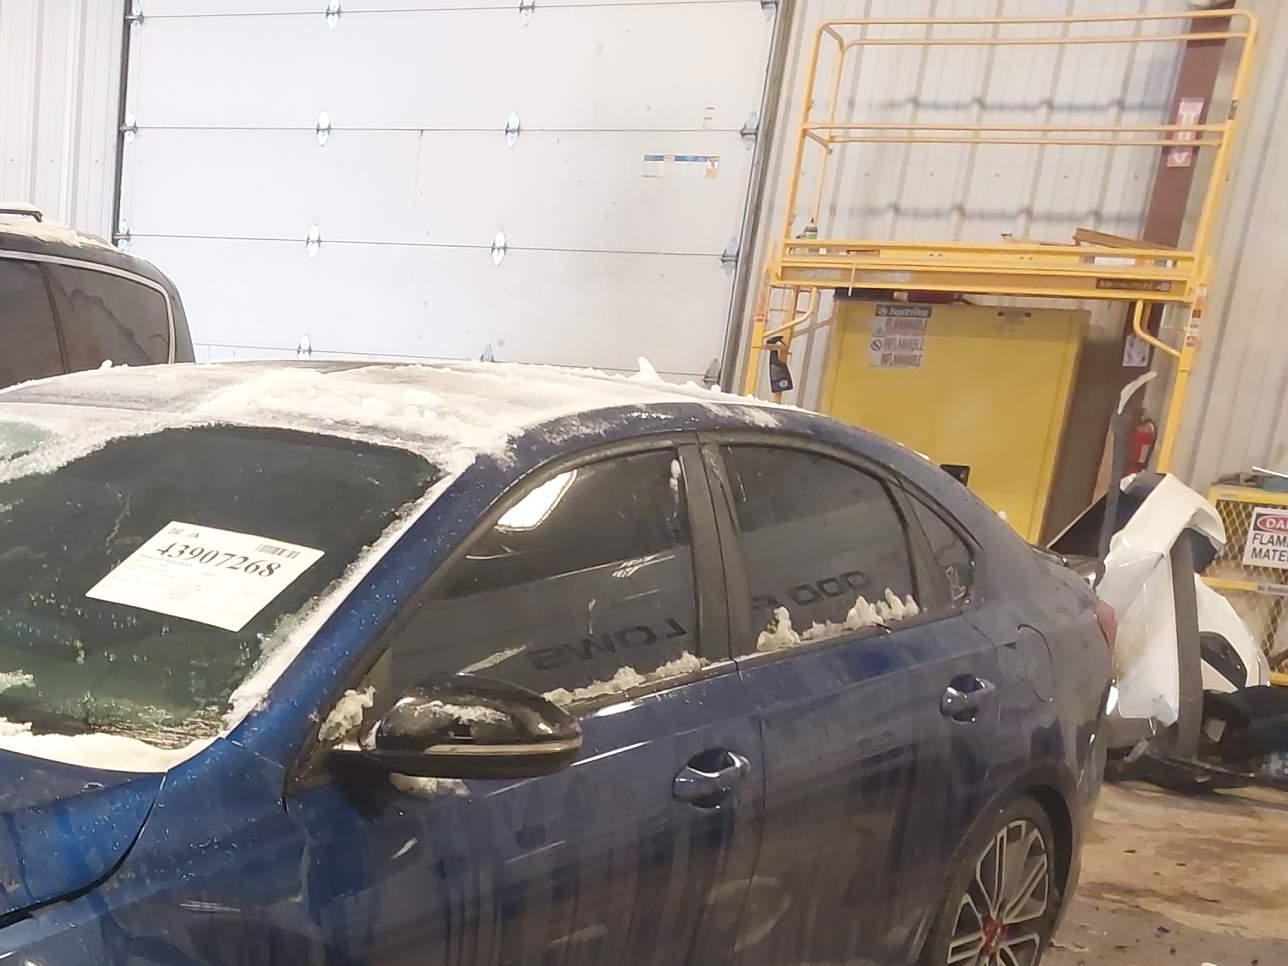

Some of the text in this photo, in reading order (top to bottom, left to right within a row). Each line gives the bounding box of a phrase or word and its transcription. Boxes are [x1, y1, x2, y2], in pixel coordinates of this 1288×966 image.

[1266, 517, 1288, 530] DA
[1252, 532, 1288, 548] FLAM
[156, 542, 282, 578] 43907268
[1251, 547, 1288, 562] MATE
